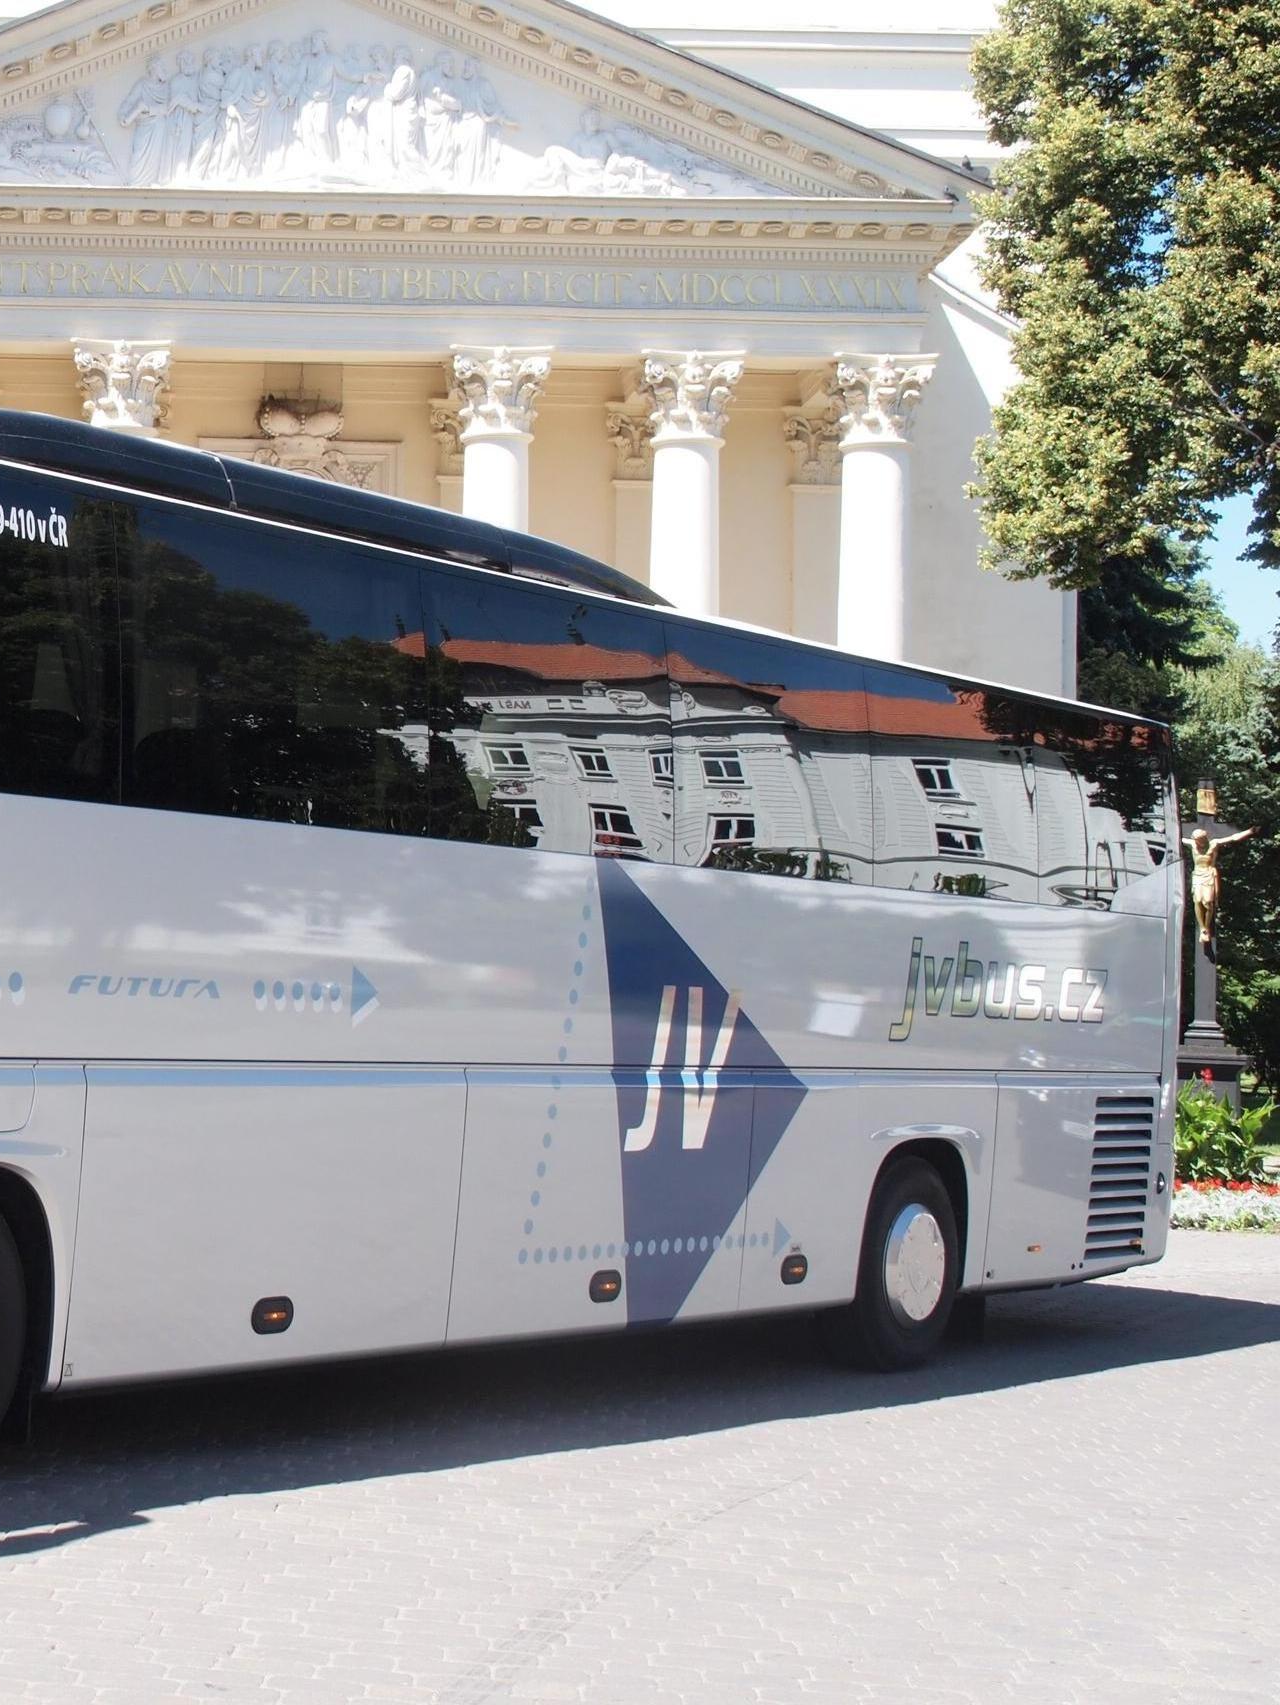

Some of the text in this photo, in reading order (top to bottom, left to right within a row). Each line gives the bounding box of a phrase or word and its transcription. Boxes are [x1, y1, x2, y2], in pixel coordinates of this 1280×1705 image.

[522, 269, 634, 304] FECIT
[48, 506, 69, 548] ČR
[67, 974, 221, 1000] FUTURA
[888, 936, 1109, 1042] jvbus.cz
[623, 984, 744, 1152] JV
